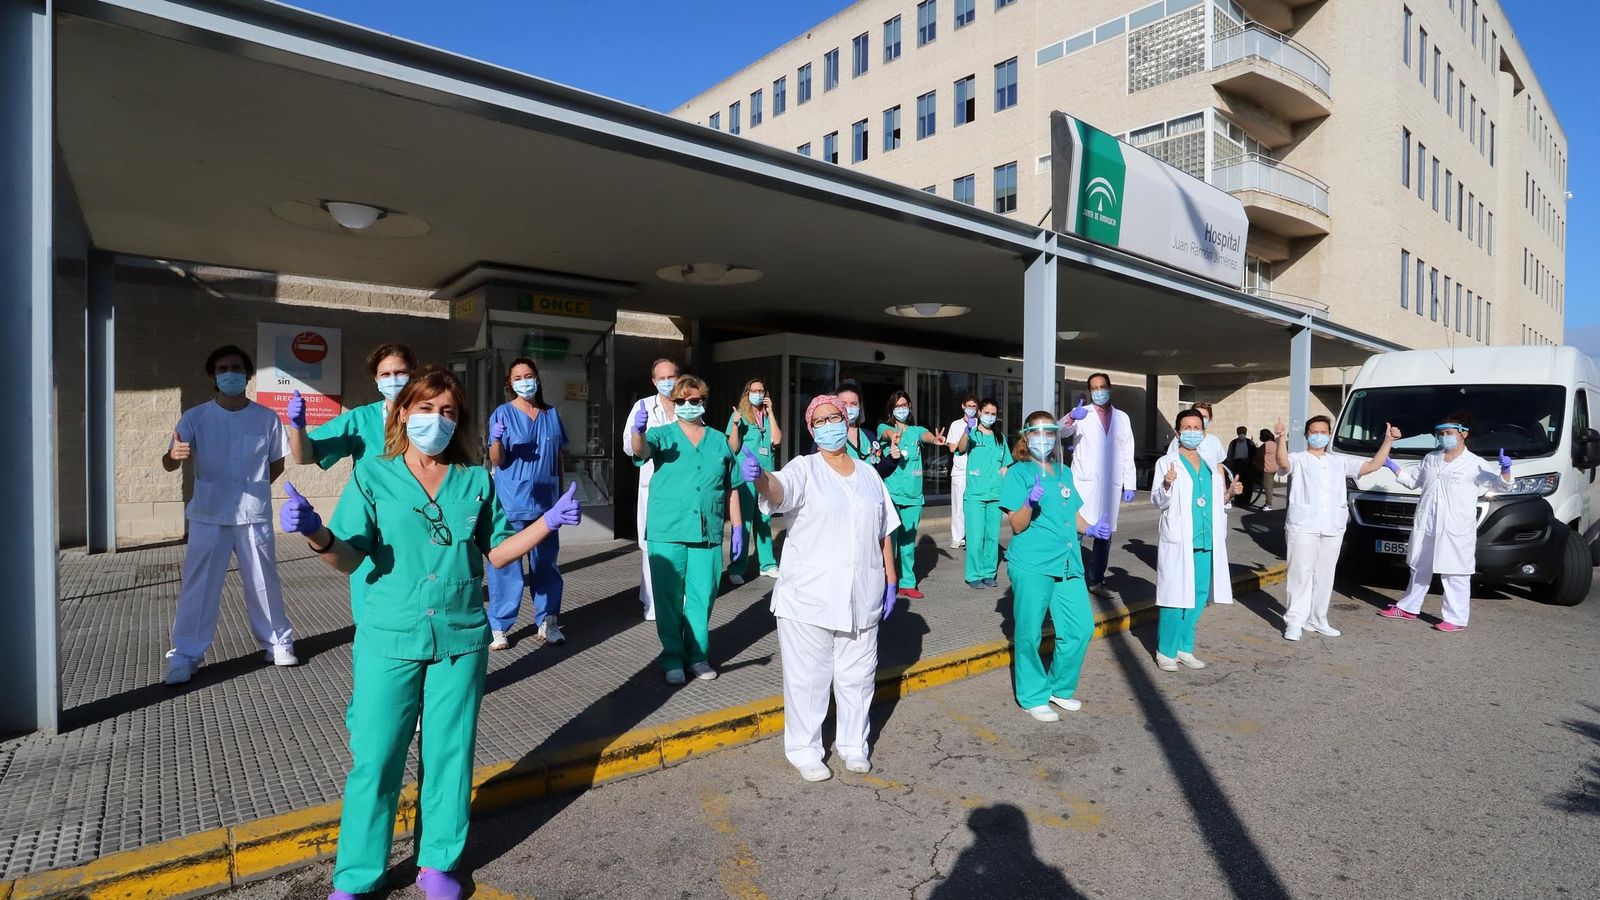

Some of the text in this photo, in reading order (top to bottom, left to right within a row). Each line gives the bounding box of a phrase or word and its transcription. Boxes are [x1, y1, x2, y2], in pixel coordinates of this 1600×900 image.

[1204, 222, 1241, 253] Hospital
[1172, 237, 1189, 253] Juan
[1190, 241, 1213, 261] Ramón
[539, 297, 586, 313] ONCE
[277, 377, 290, 385] sin
[274, 395, 323, 403] ¡RECRDE!
